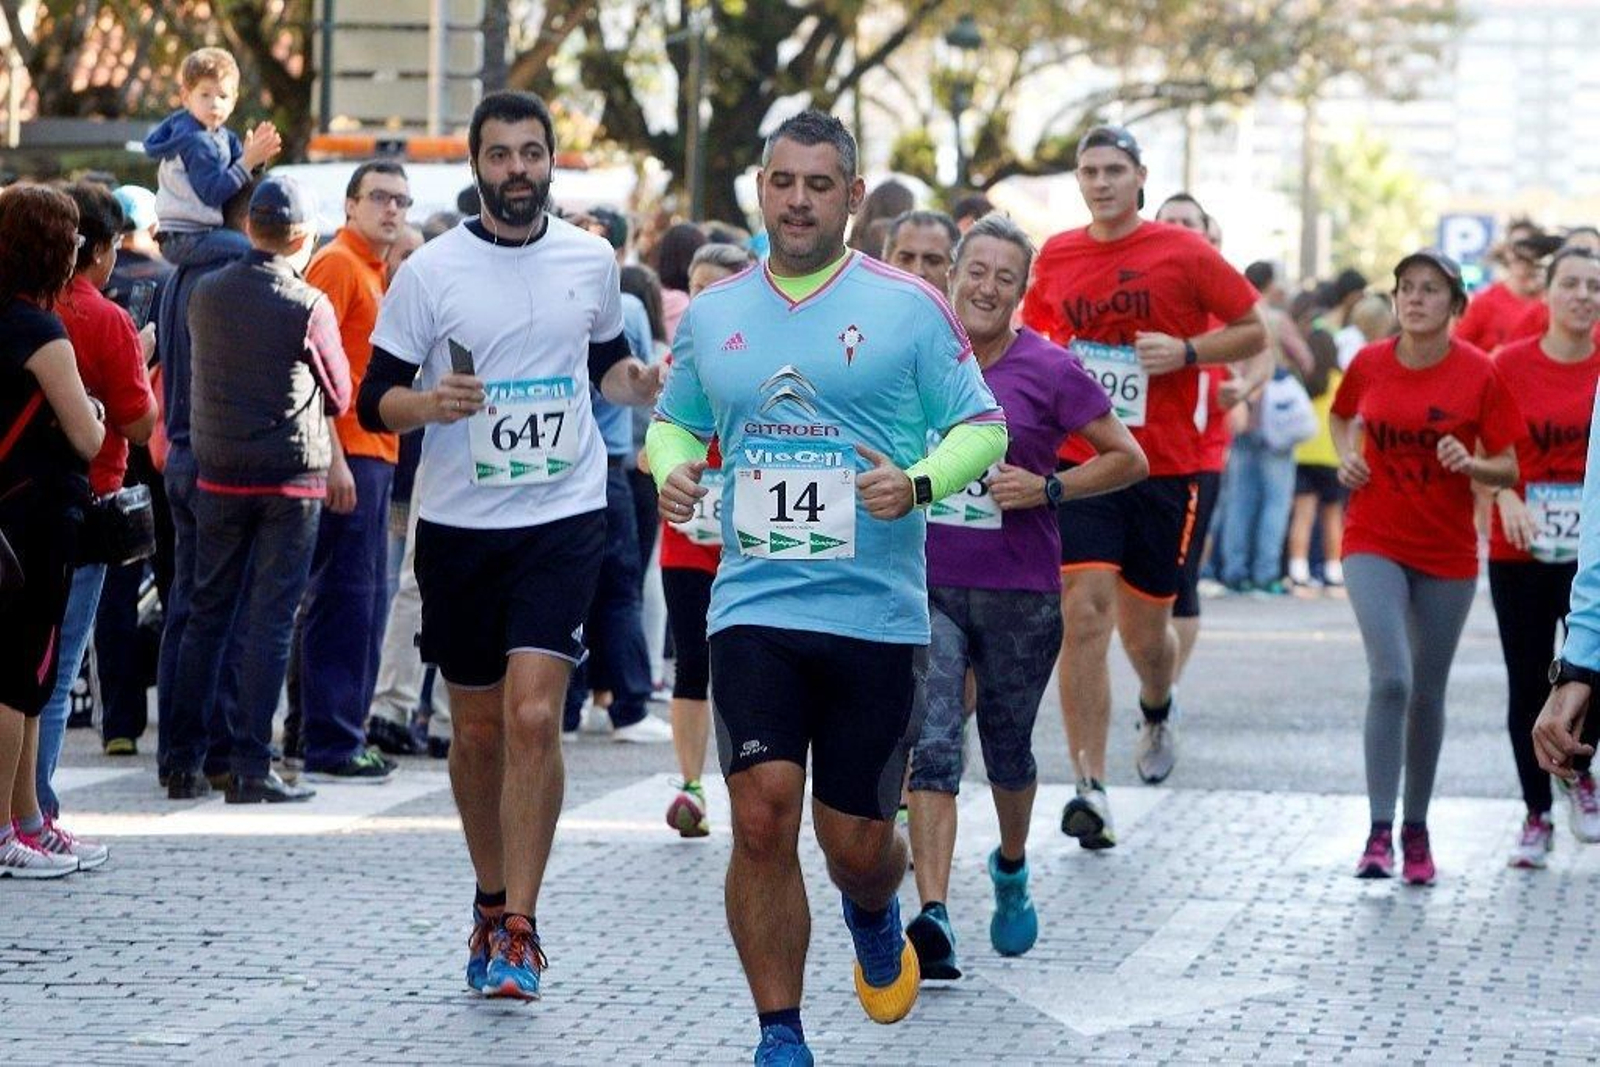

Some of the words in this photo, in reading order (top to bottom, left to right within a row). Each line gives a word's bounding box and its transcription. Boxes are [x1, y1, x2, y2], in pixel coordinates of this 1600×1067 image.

[491, 411, 565, 452] 647
[744, 422, 840, 437] CITROËN
[768, 480, 826, 522] 14
